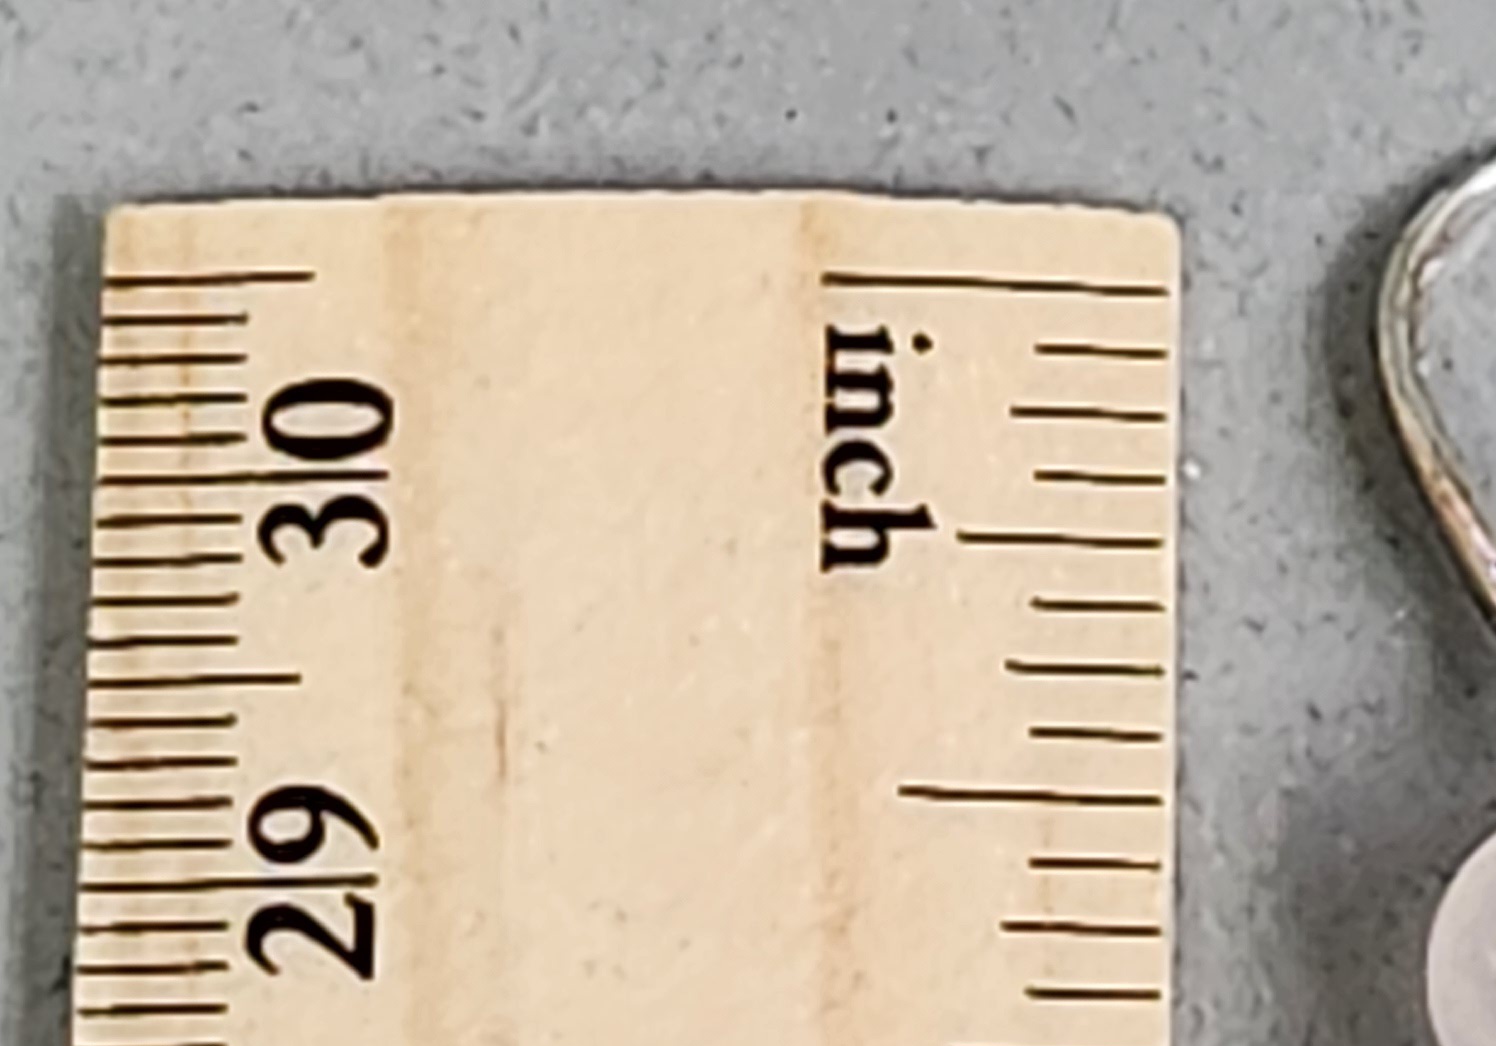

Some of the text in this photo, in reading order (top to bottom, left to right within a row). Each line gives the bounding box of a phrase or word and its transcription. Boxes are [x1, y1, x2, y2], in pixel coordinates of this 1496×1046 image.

[259, 377, 394, 567] 30
[821, 324, 933, 571] inch
[246, 786, 380, 979] 29
